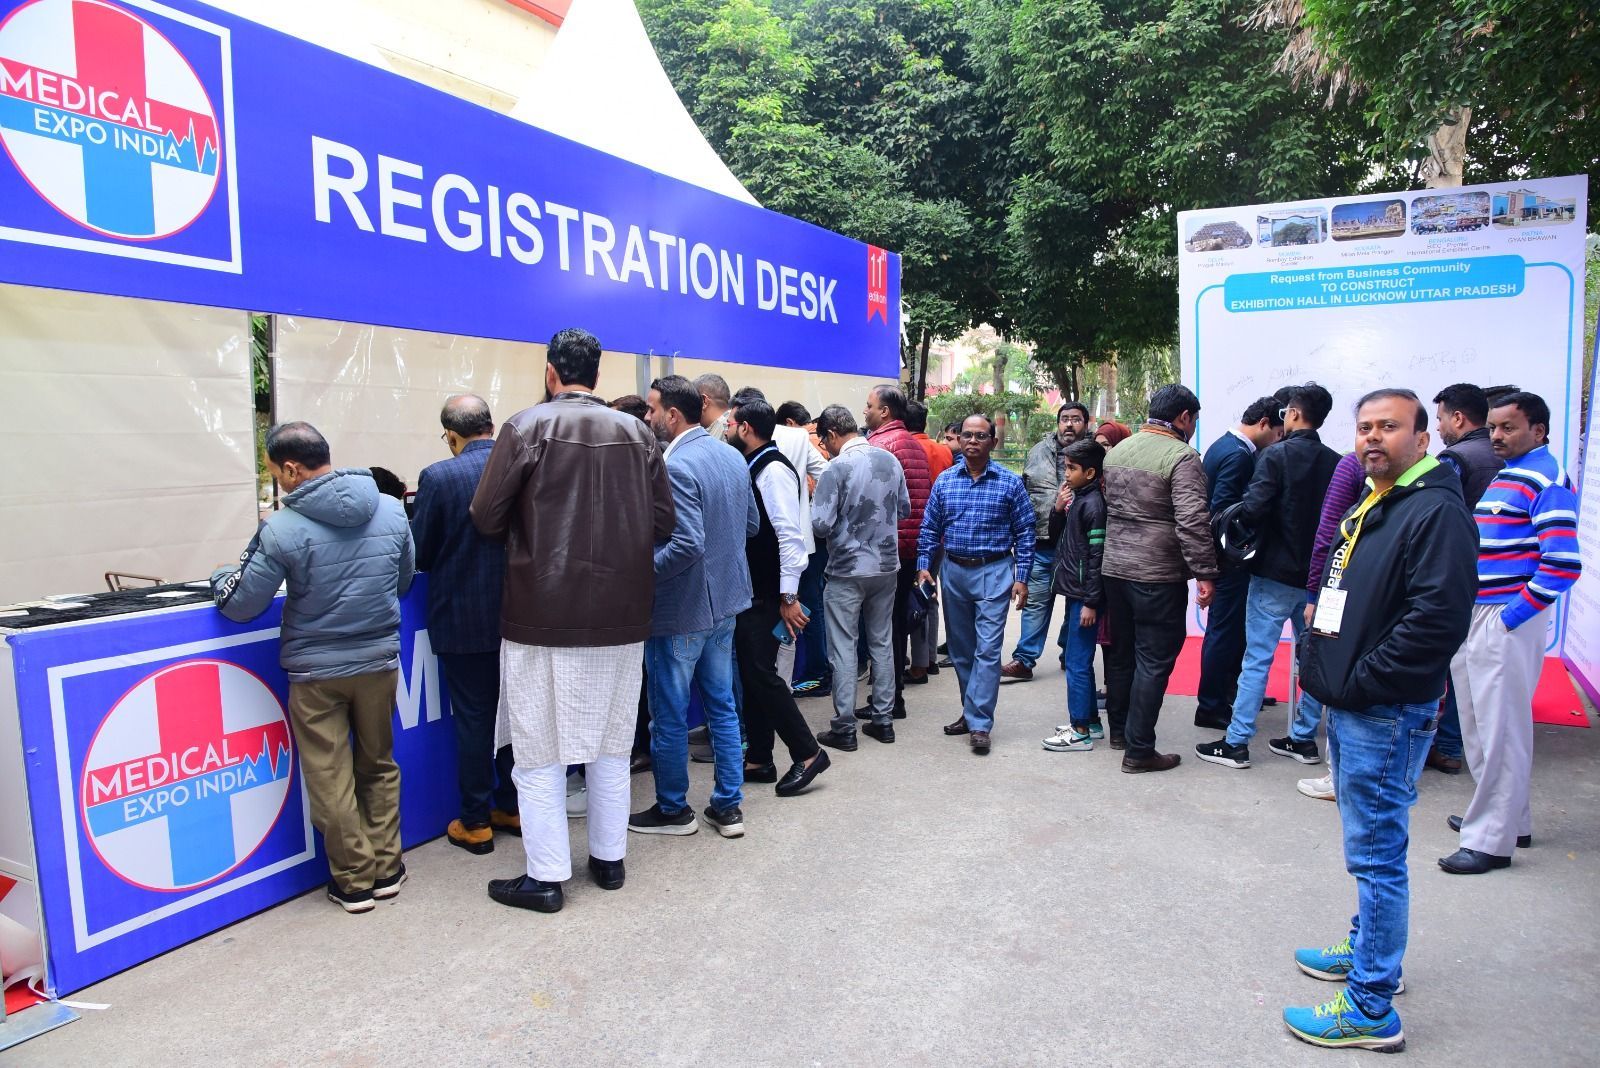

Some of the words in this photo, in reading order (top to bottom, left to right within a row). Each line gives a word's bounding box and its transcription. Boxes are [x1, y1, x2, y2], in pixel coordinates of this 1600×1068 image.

[0, 60, 163, 132] MEDICAL
[34, 107, 107, 145] EXPO
[114, 128, 182, 164] INDIA
[311, 135, 745, 307] REGISTRATION
[756, 259, 839, 324] DESK
[1231, 297, 1295, 310] EXHIBITION
[1298, 294, 1328, 306] HALL
[1330, 294, 1342, 304] IN
[1345, 290, 1407, 304] LUCKNOW
[1410, 287, 1451, 300] UTTAR
[1454, 284, 1517, 296] PRADESH
[1270, 273, 1315, 285] Request
[1318, 271, 1344, 281] from
[1347, 267, 1399, 279] Business
[1402, 262, 1471, 276] Community
[1321, 282, 1337, 292] TO
[1340, 278, 1415, 292] CONSTRUCT
[90, 739, 240, 803] MEDICAL
[122, 785, 190, 823] EXPO
[194, 764, 258, 801] INDIA
